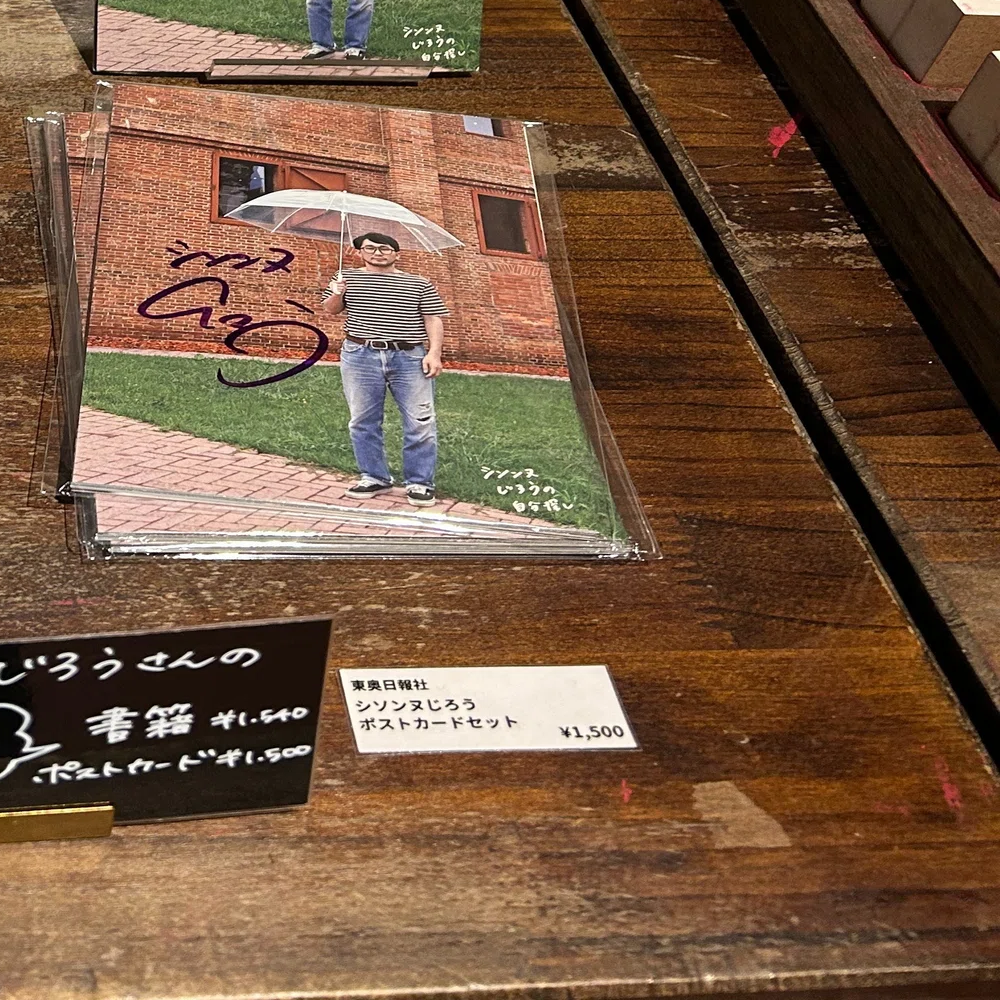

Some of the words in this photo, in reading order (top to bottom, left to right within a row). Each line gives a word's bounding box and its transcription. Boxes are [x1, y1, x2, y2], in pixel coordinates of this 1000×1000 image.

[350, 678, 430, 692] 東奥日報社
[355, 698, 476, 713] シソンヌじろう
[85, 702, 196, 745] 書籍
[359, 715, 518, 731] ポストカードセット
[559, 725, 625, 741] ¥1,500
